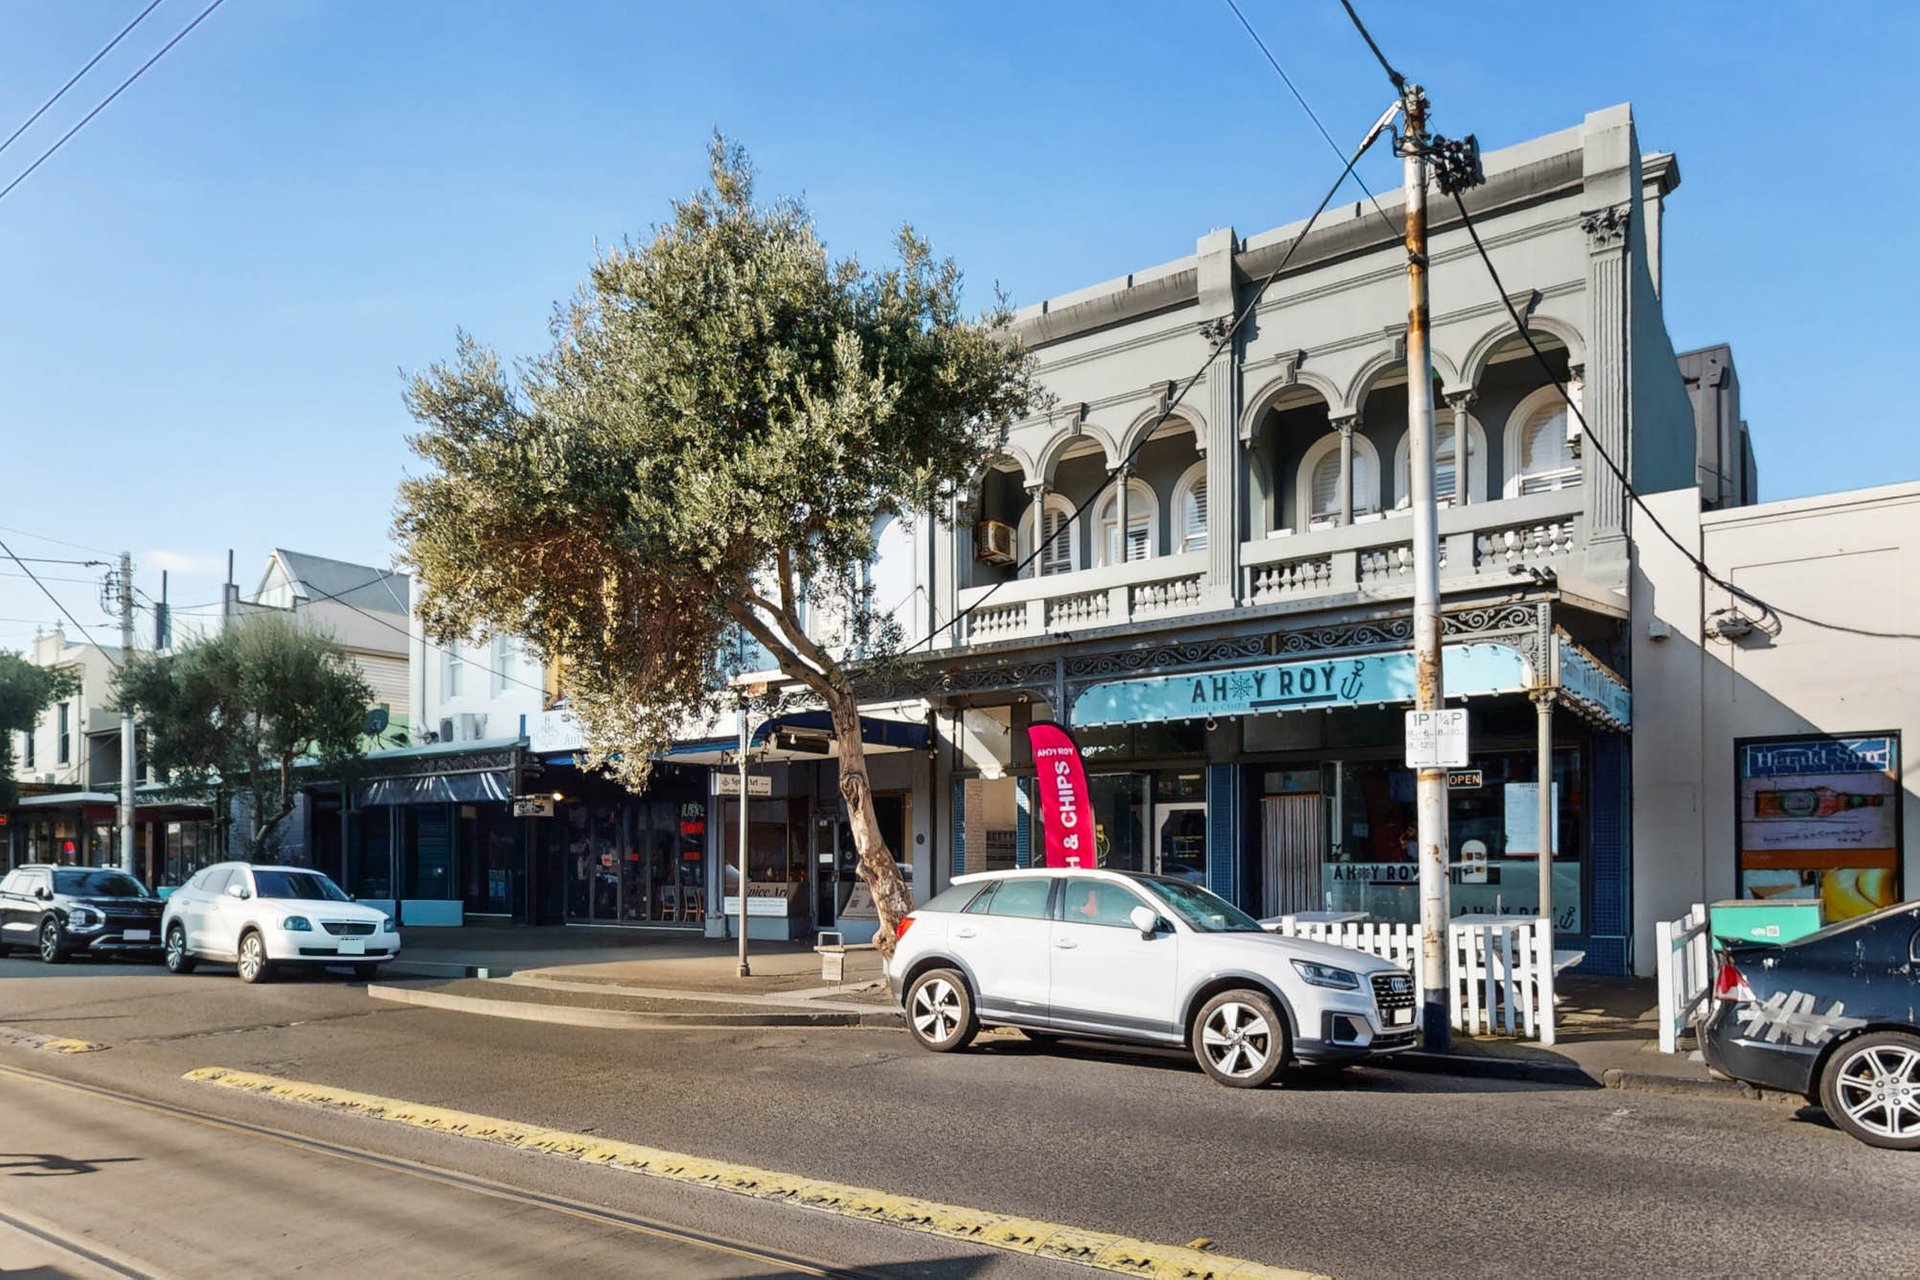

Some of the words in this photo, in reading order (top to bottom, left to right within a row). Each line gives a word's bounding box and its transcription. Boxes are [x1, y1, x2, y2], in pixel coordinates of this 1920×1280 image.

[1279, 666, 1337, 696] ROY
[1057, 747, 1074, 757] ROY
[1757, 750, 1827, 768] Herald
[1449, 775, 1481, 785] OPEN
[1055, 760, 1079, 828] CHIPS
[1063, 834, 1080, 850] &
[1386, 865, 1420, 880] ROY
